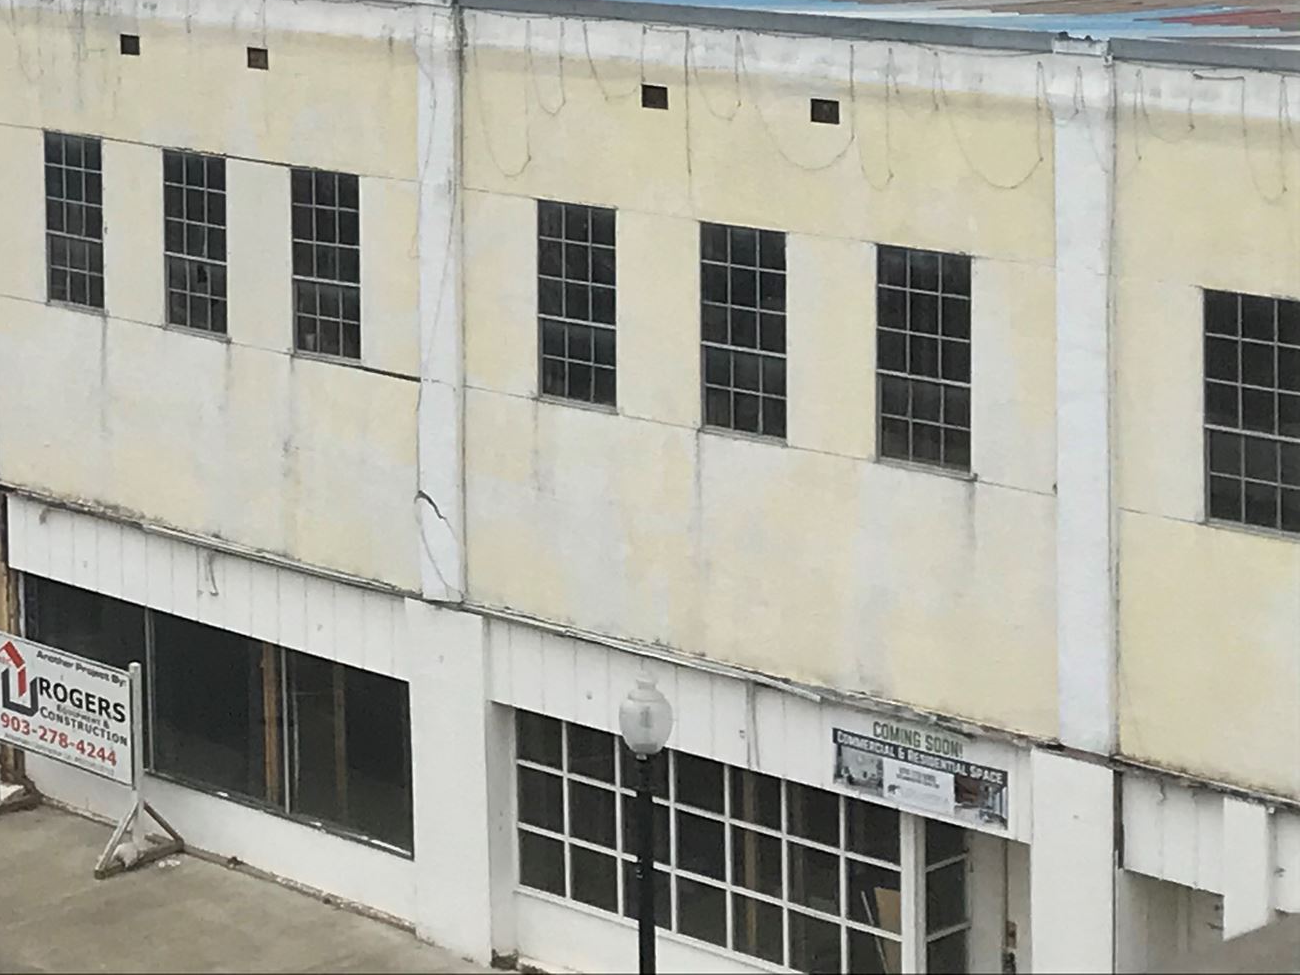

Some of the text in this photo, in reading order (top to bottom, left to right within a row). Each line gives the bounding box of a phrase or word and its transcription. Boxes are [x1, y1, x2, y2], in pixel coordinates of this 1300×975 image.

[75, 662, 110, 681] Project
[39, 677, 126, 723] ROGERS
[0, 712, 117, 766] 903-278-4244
[40, 706, 128, 746] CONSTRUCTION
[873, 721, 963, 759] COMING SOON!
[837, 730, 895, 758] COMMERCIAL
[907, 749, 968, 777] RESIDENTIAL
[970, 765, 1003, 785] SPACE
